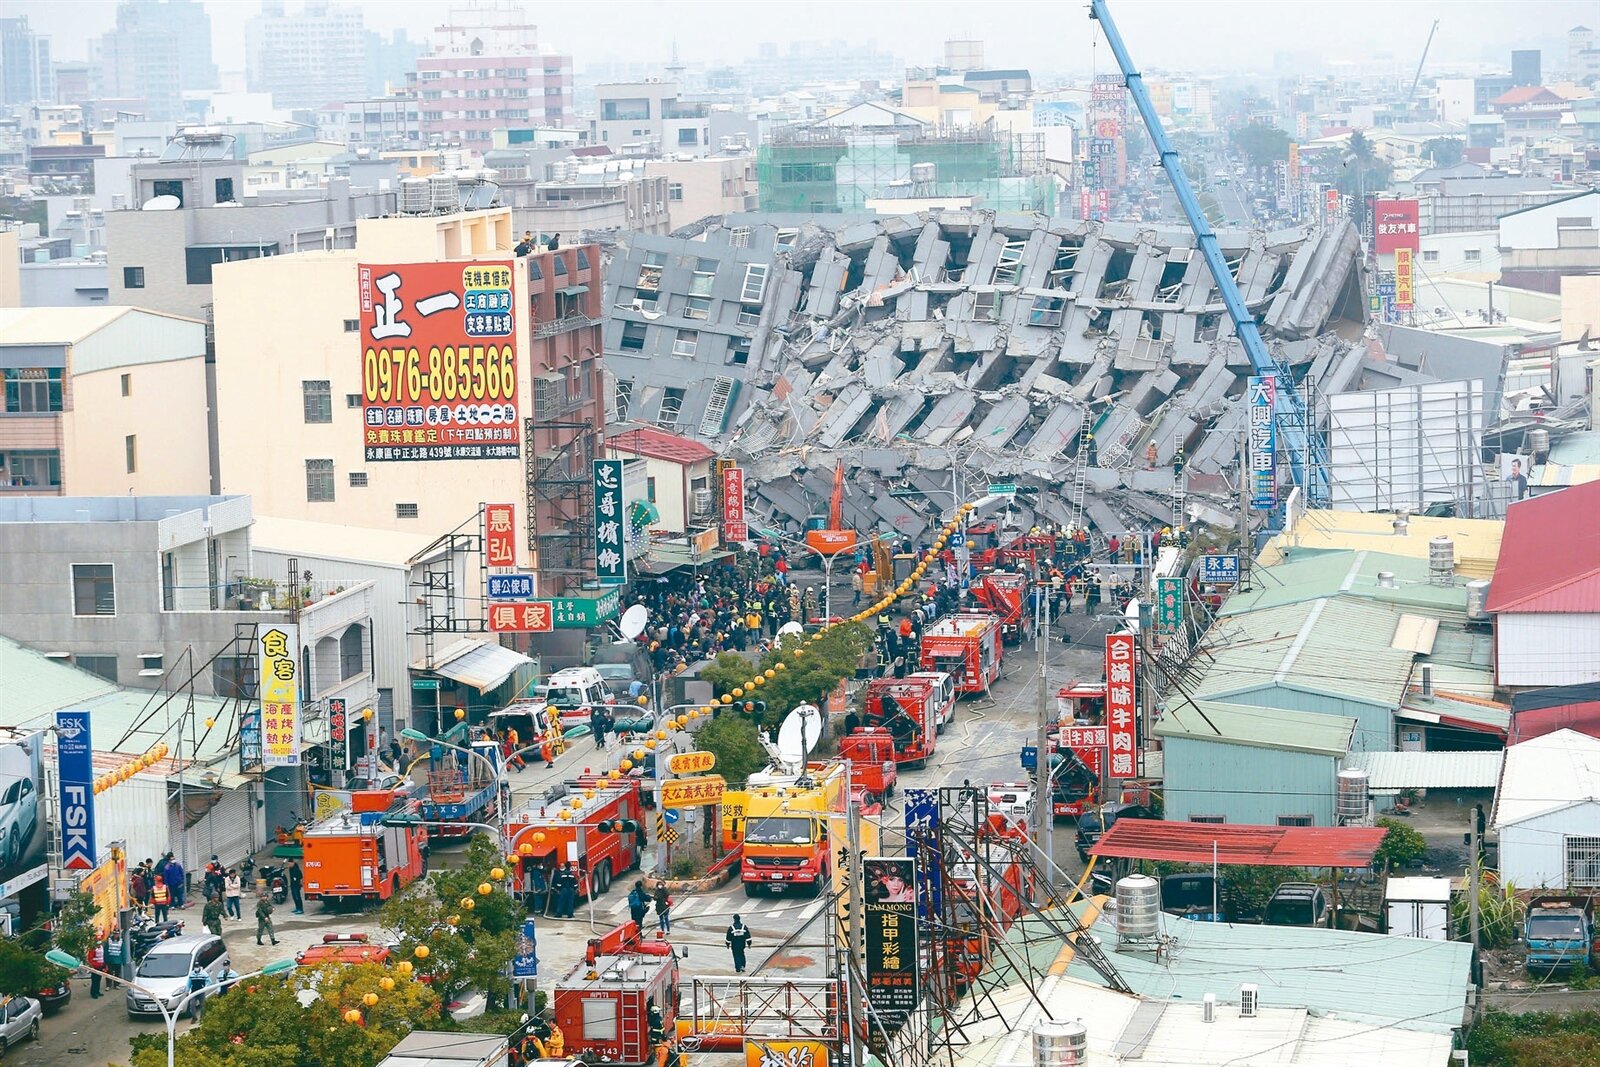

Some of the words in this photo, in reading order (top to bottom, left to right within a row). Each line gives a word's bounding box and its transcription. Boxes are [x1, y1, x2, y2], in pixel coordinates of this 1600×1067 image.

[464, 271, 510, 286] 汽機車借款
[370, 272, 461, 341] 正一
[466, 315, 511, 333] 支客票貼現
[364, 344, 515, 402] 0976-885566
[1251, 382, 1272, 471] 大興汽車
[489, 509, 514, 563] 惠弘
[596, 463, 621, 574] 忠哥檳榔
[1207, 557, 1237, 570] 永泰
[491, 579, 530, 595] 辦公傢俱
[260, 628, 296, 681] 食客
[265, 703, 293, 715] 海產
[265, 718, 293, 730] 燒烤
[1111, 639, 1132, 774] 合滿味牛肉湯
[59, 717, 87, 732] FSK
[265, 733, 294, 745] 熱炒
[1072, 729, 1106, 745] 牛肉湯
[65, 785, 88, 850] FSK
[882, 914, 900, 969] 指甲彩繪
